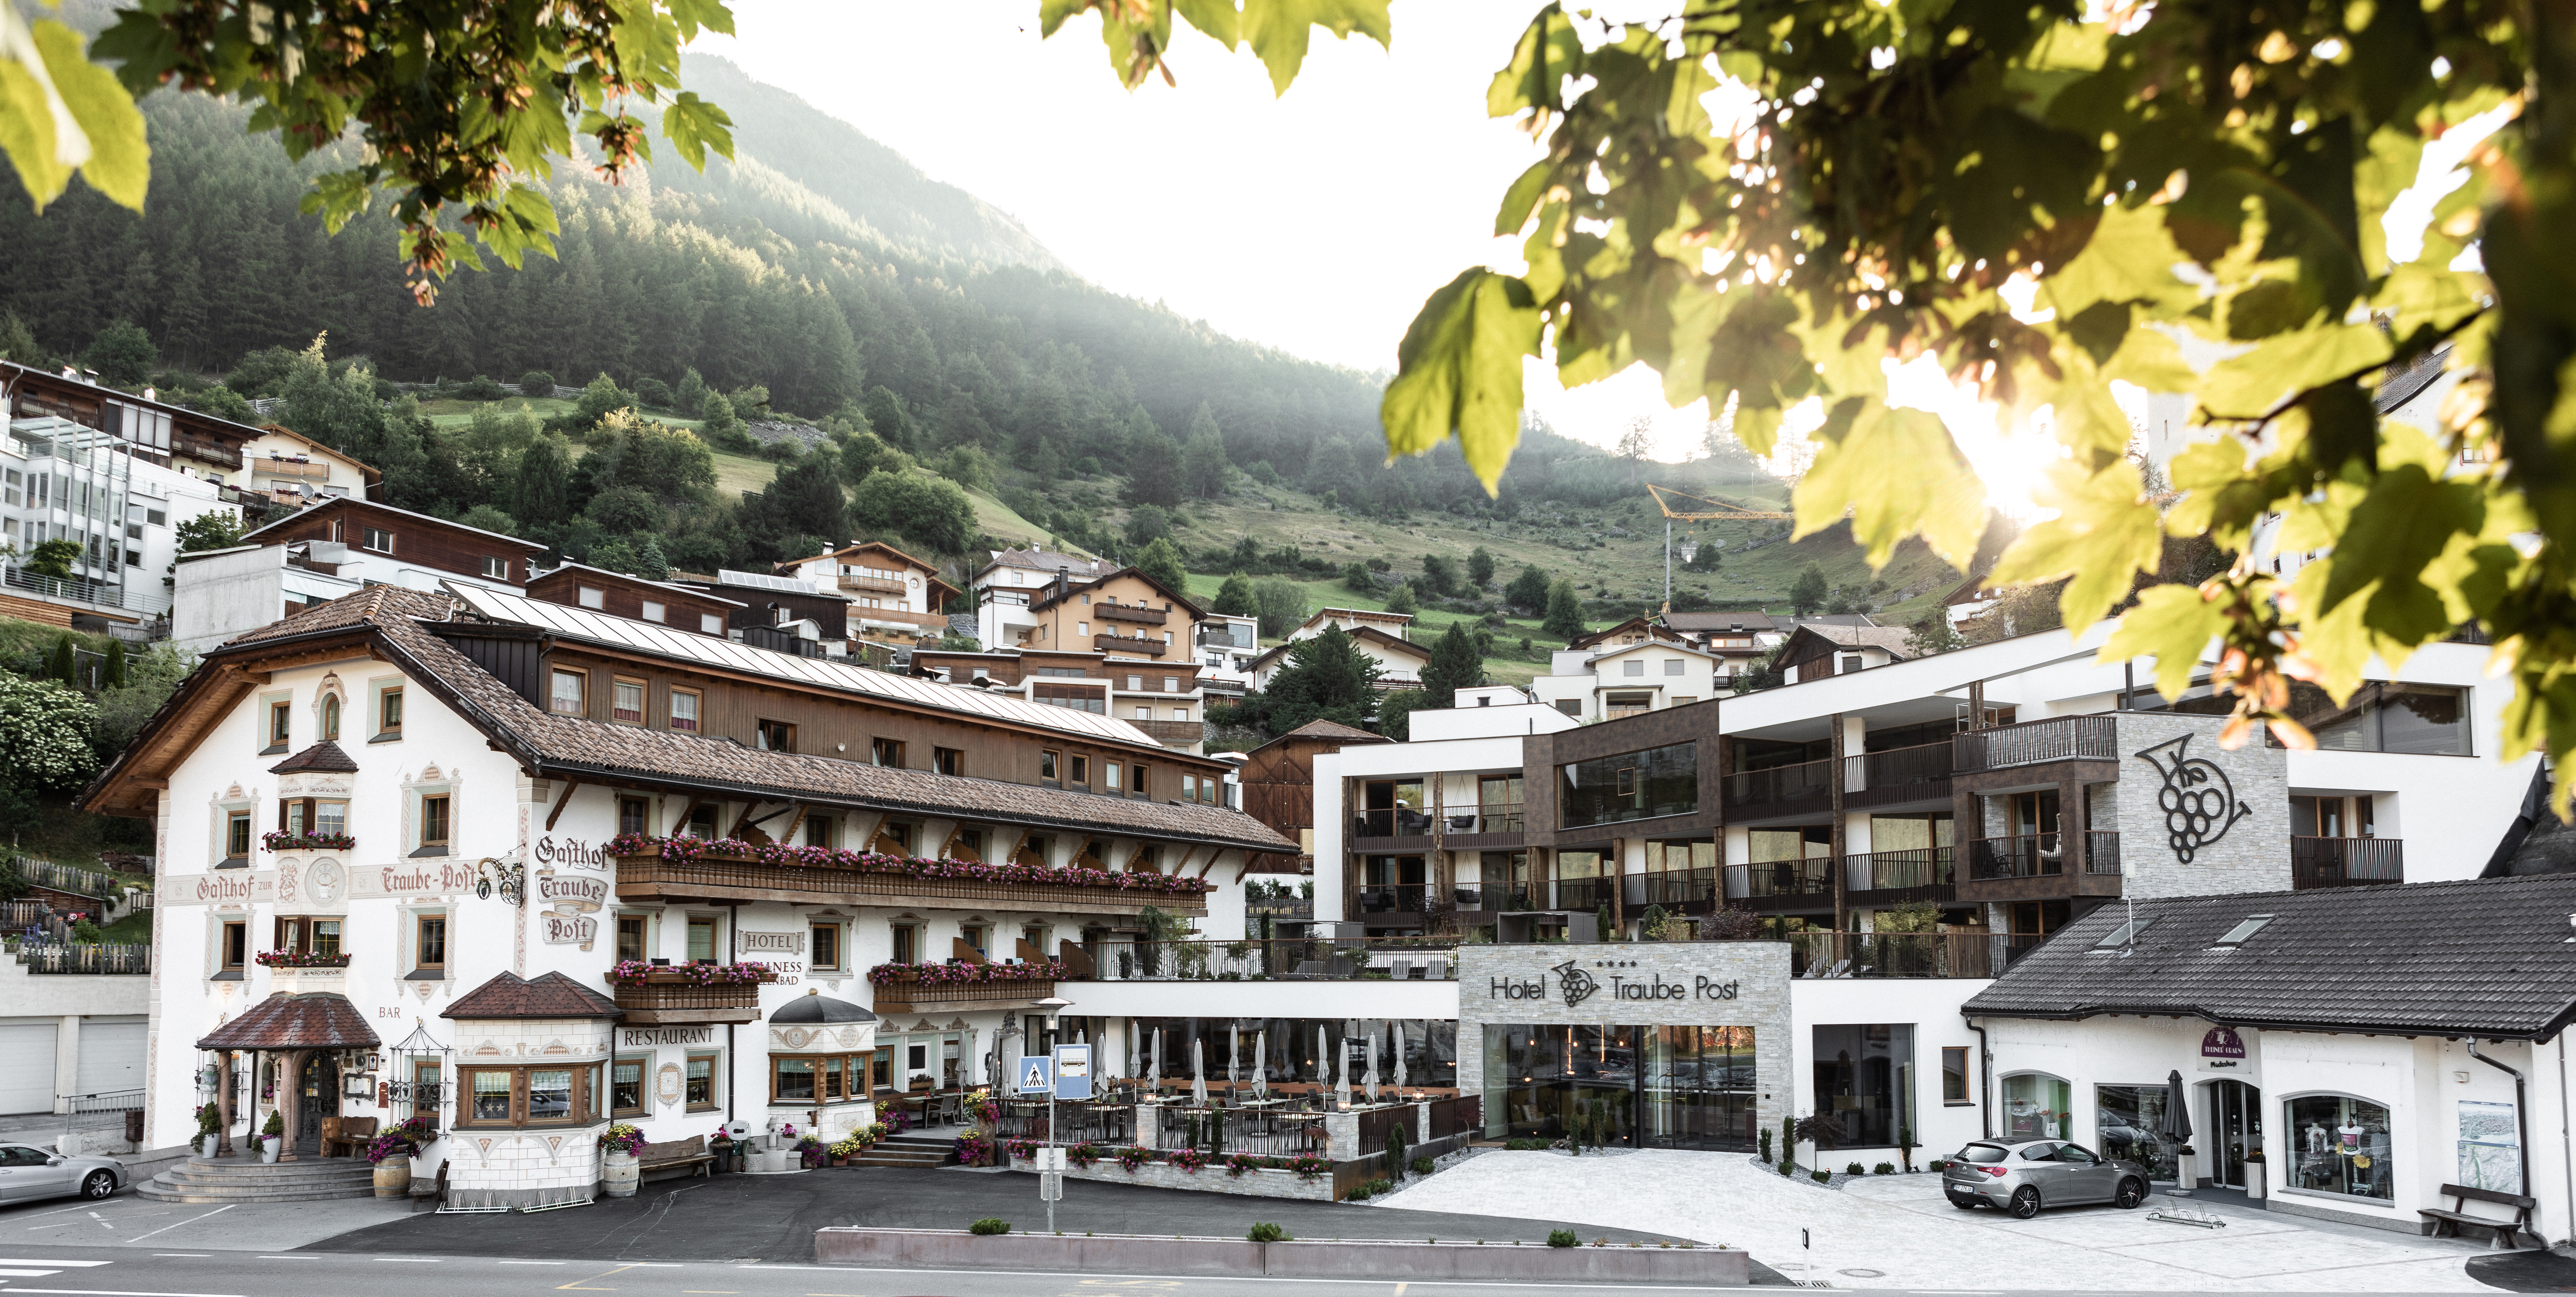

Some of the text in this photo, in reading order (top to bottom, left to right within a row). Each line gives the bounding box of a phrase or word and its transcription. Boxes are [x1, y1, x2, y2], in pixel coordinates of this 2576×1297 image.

[258, 881, 273, 890] ZUR
[548, 918, 588, 942] Post
[748, 935, 792, 948] HOTEL
[1492, 974, 1739, 999] Hotel Traube Post
[379, 1007, 401, 1019] BAR
[624, 1028, 714, 1046] RESTAURANT
